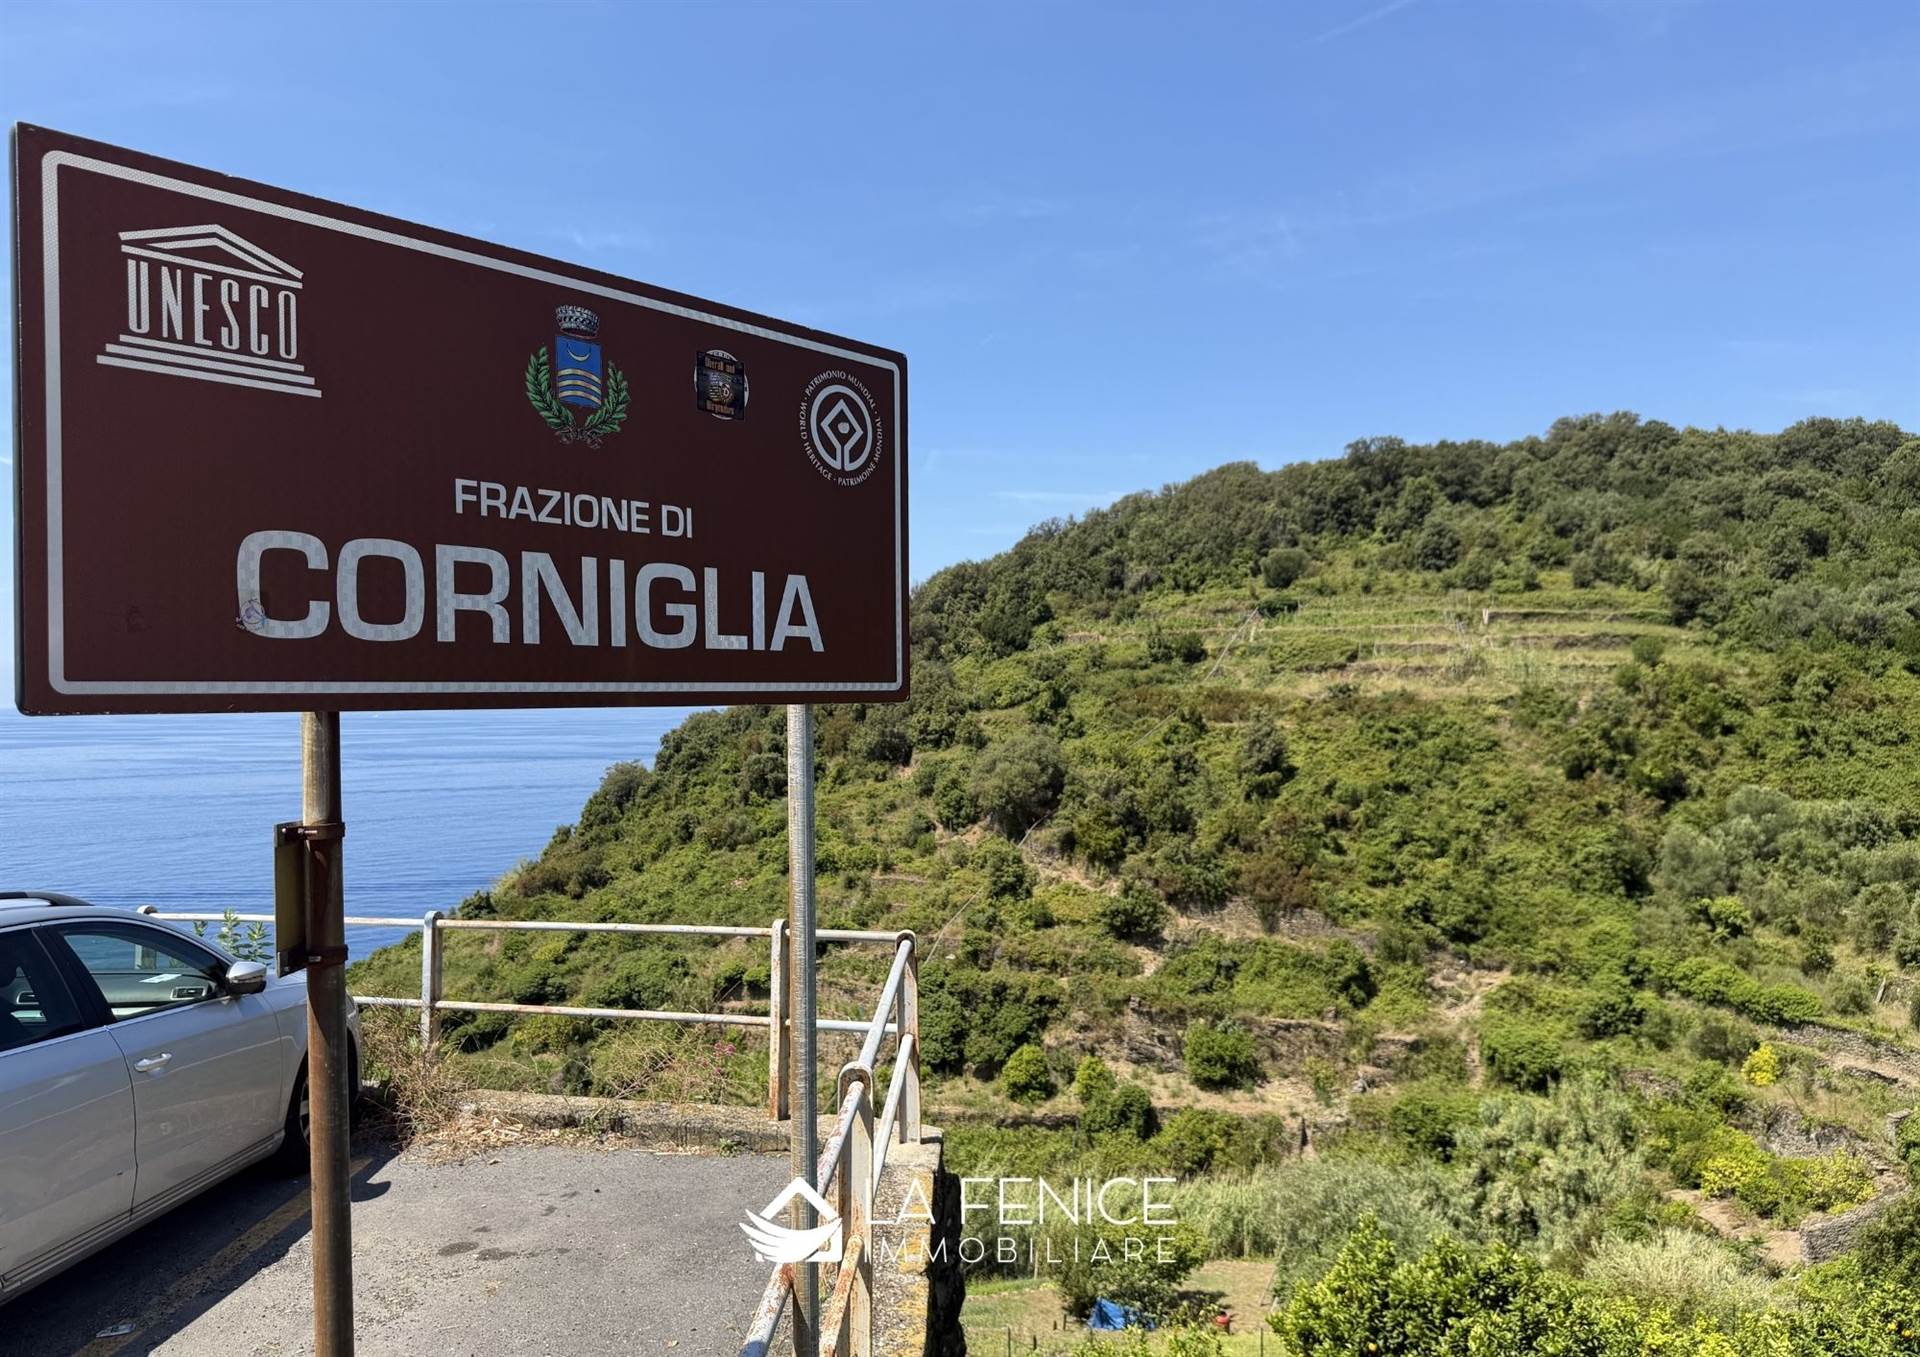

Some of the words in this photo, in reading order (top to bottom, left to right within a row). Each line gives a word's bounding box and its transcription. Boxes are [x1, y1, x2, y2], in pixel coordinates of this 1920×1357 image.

[127, 258, 298, 360] UNESCO
[804, 370, 846, 397] PATRIMONIO
[847, 374, 876, 409] MUNDIAL
[799, 402, 808, 440] WORLD
[803, 442, 833, 481] HERITAGE
[837, 461, 876, 487] PATRIMOINE
[873, 416, 883, 463] MONDIAL
[455, 478, 650, 533] FRAZIONE
[661, 504, 693, 538] DI
[237, 531, 824, 652] CORNIGLIA
